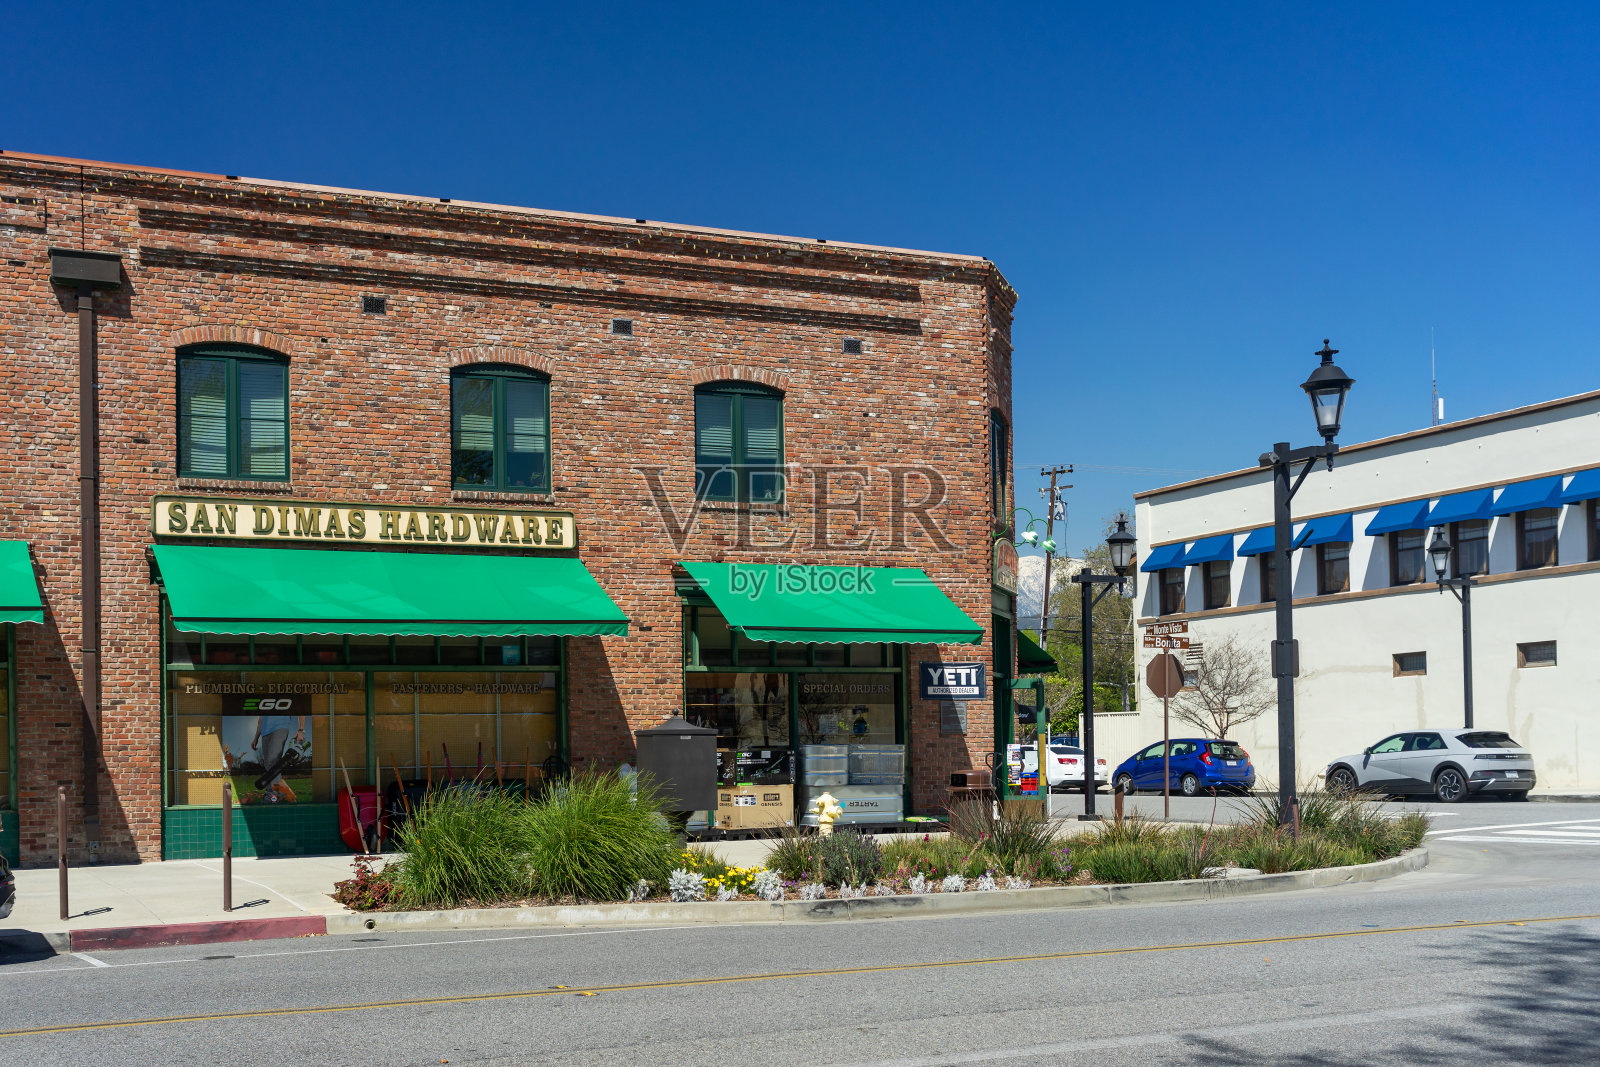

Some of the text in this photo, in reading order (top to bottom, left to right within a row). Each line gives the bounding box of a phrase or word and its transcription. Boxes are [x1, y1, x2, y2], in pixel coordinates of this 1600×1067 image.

[168, 502, 564, 545] SAN DIMAS HARDWARE
[1153, 625, 1169, 635] Monte
[1169, 623, 1182, 633] Vista
[1155, 637, 1181, 648] Bonita
[927, 668, 978, 685] YETI
[185, 683, 348, 694] PLUMBING ELECTRICAL
[392, 683, 542, 694] FASTENERS HARDWARE
[803, 684, 890, 694] SPECIAL ORDERS
[243, 699, 292, 710] EGO
